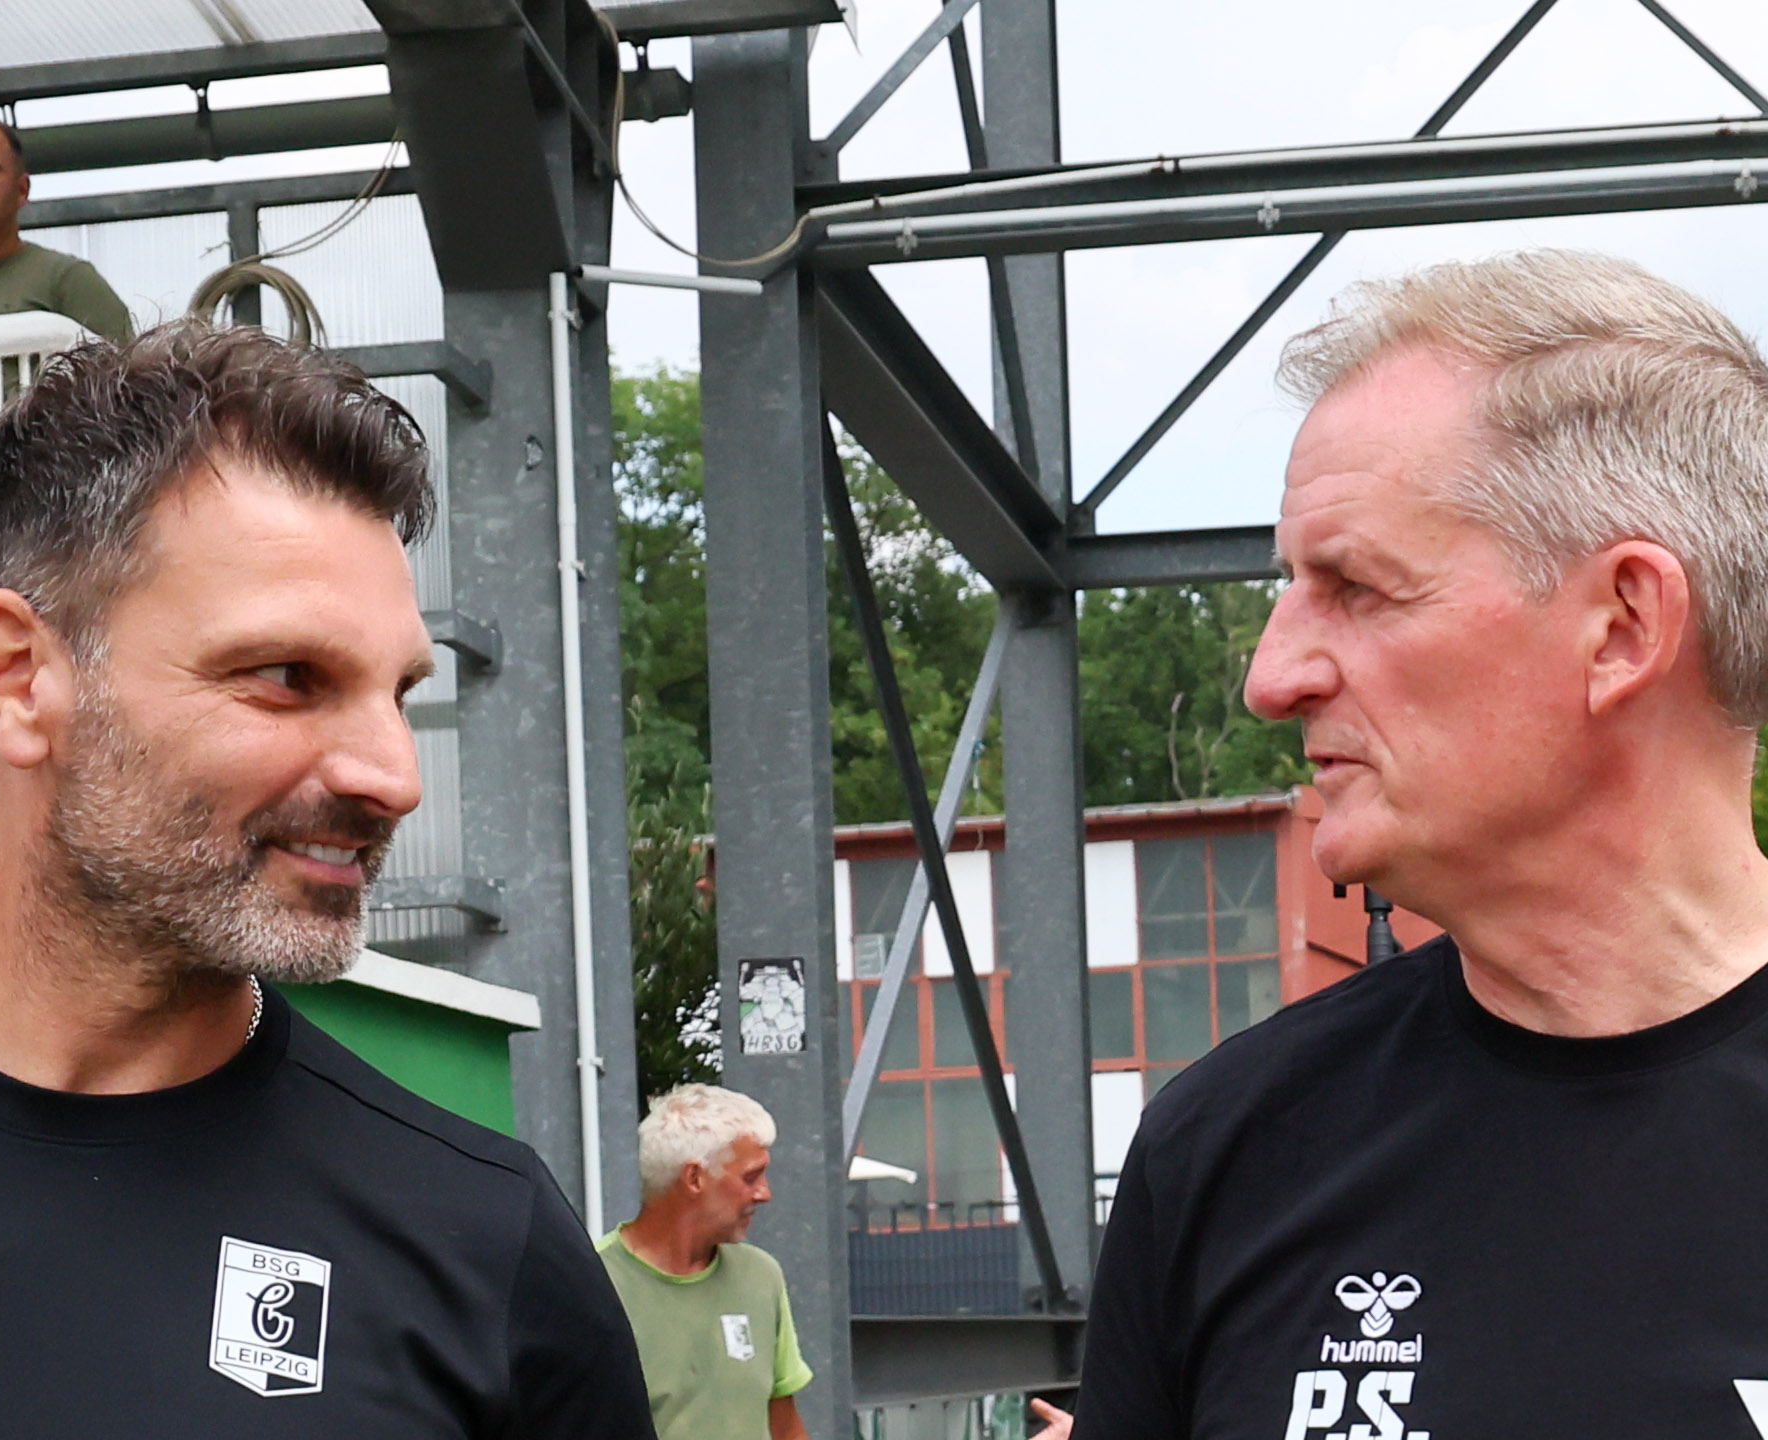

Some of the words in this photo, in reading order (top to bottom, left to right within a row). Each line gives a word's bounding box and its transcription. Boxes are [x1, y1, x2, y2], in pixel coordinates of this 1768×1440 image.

[252, 1254, 301, 1277] BSG
[225, 1345, 309, 1377] LEIPZIG
[1320, 1333, 1423, 1363] hummel
